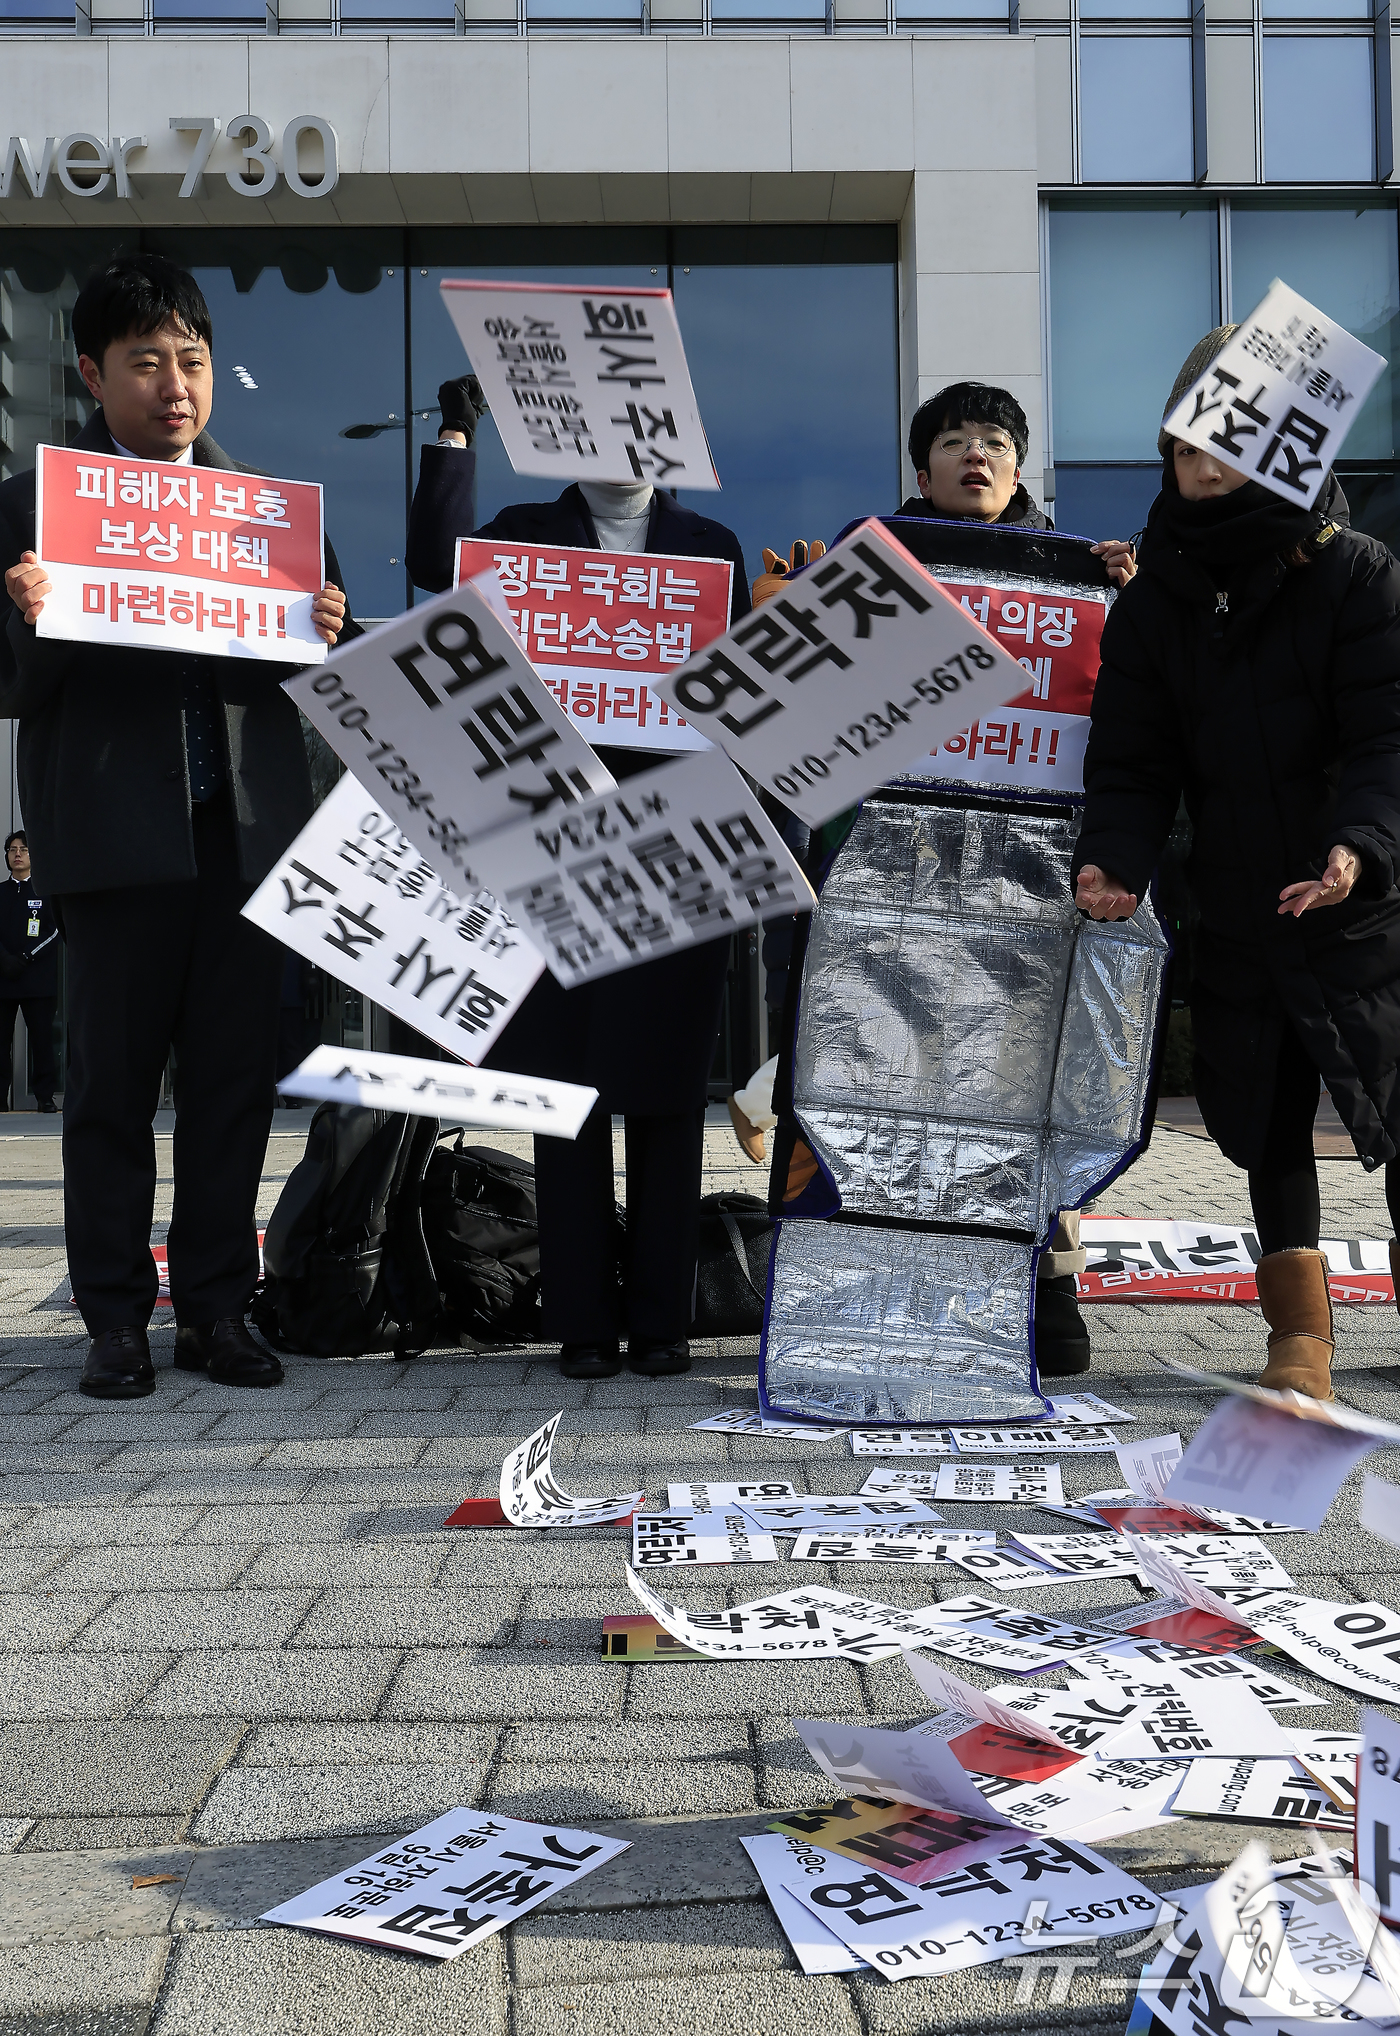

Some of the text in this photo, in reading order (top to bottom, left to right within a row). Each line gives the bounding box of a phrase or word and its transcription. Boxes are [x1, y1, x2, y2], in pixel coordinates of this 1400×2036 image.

[169, 114, 340, 198] 730
[583, 300, 686, 482] 회사 주소
[1186, 362, 1330, 495] 집 주소
[75, 465, 291, 528] 피해자 보호
[95, 518, 269, 579] 보상 대책
[82, 581, 286, 638] 마련하라!!
[493, 554, 700, 612] 정부 국회는
[674, 541, 934, 738] 연락처
[997, 601, 1077, 647] 의장
[772, 643, 997, 798] 010-1234-5678
[278, 857, 387, 962] 주소
[386, 936, 511, 1035] 회사
[958, 1427, 1111, 1443] 이메일
[753, 1501, 917, 1518] 집 주소
[1009, 1466, 1048, 1501] 회사 주소
[637, 1516, 698, 1565] 연락처
[939, 1600, 1120, 1651] 가족집
[321, 1820, 508, 1921] 서울시 자하문로
[342, 1842, 434, 1889] 9길 16
[379, 1834, 603, 1947] 가족집
[874, 1894, 1157, 1967] 010-1234-5678
